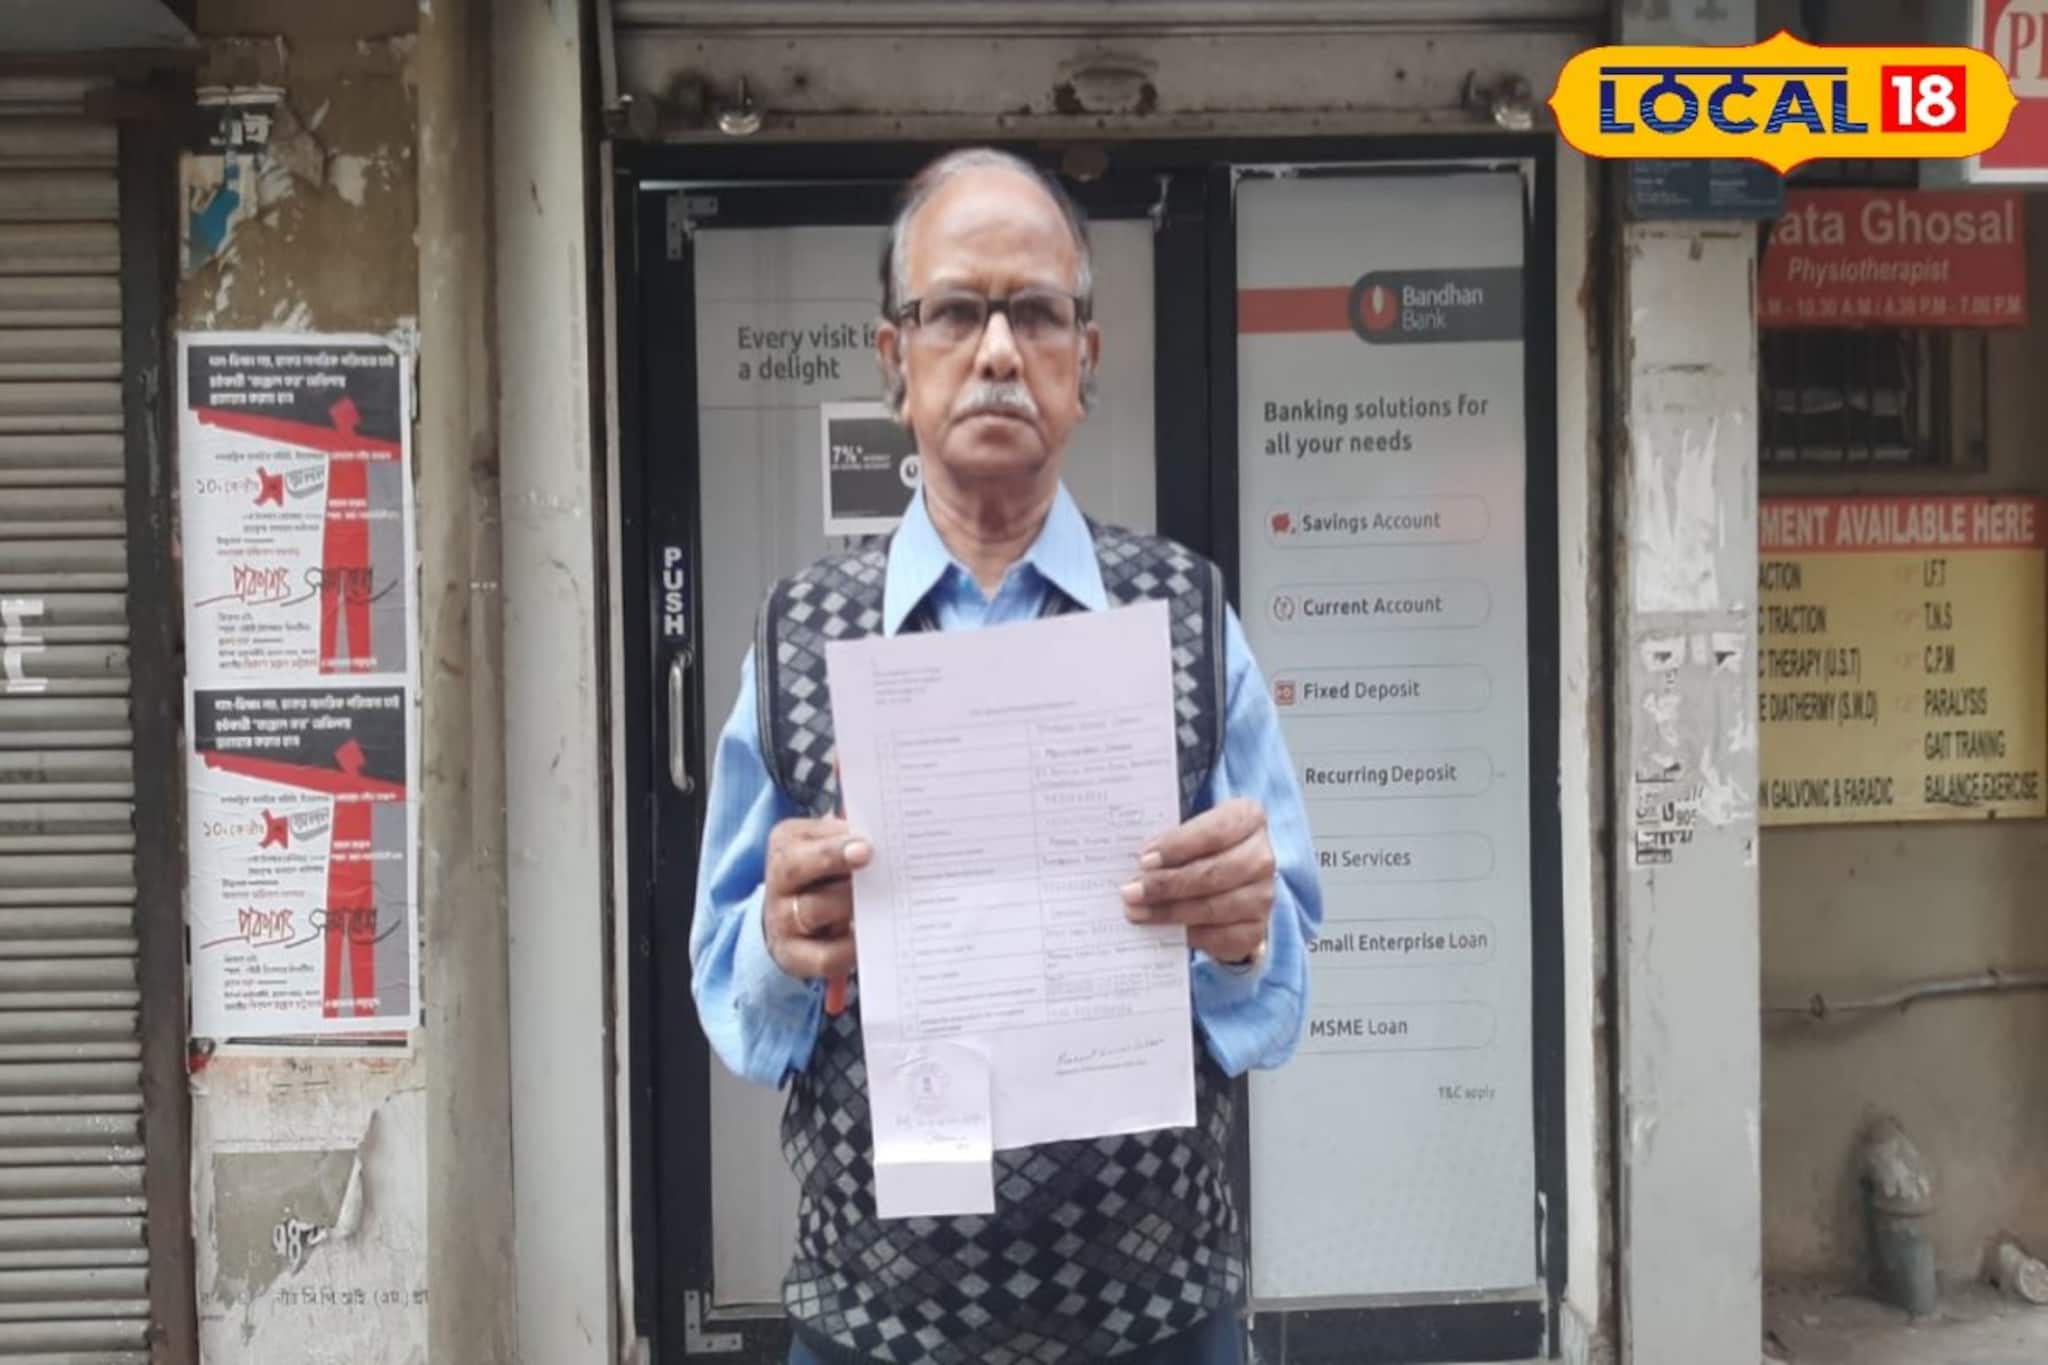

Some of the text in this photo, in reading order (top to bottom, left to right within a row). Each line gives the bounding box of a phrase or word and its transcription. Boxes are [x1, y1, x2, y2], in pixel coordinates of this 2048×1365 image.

[1768, 198, 2015, 245] ata Ghosal
[1787, 255, 1949, 288] Physiotherapist
[1403, 283, 1484, 306] Bandhan
[1403, 308, 1447, 330] Bank
[738, 326, 803, 353] Every
[809, 325, 857, 349] visit
[738, 356, 840, 384] a delight
[1264, 394, 1489, 425] Banking solutions for
[1265, 429, 1413, 458] all your needs
[1302, 511, 1441, 534] Savings Account
[1835, 503, 1966, 545] AVAILABLE
[1972, 503, 2035, 543] HERE
[664, 547, 684, 636] PUSH
[1303, 596, 1443, 617] Current Account
[1768, 605, 1827, 634] TRACTION
[1768, 648, 1822, 678] THERAPY
[1303, 680, 1420, 701] Fixed Deposit
[1924, 687, 1988, 717] PARALYSIS
[1770, 692, 1837, 722] DIATHERMY
[1924, 732, 1951, 760] GAIT
[1305, 763, 1457, 786] Recurring Deposit
[1924, 771, 2039, 803] BALANCE EXERCISE
[1772, 779, 1829, 808] GALVONIC
[1833, 779, 1842, 806] &
[1844, 777, 1893, 806] FARADIC
[1315, 849, 1411, 867] RI Services
[1358, 931, 1445, 953] Enterprise
[1449, 932, 1488, 950] Loan
[1310, 1019, 1408, 1037] MSME Loan
[1438, 1085, 1496, 1102] T&C apply
